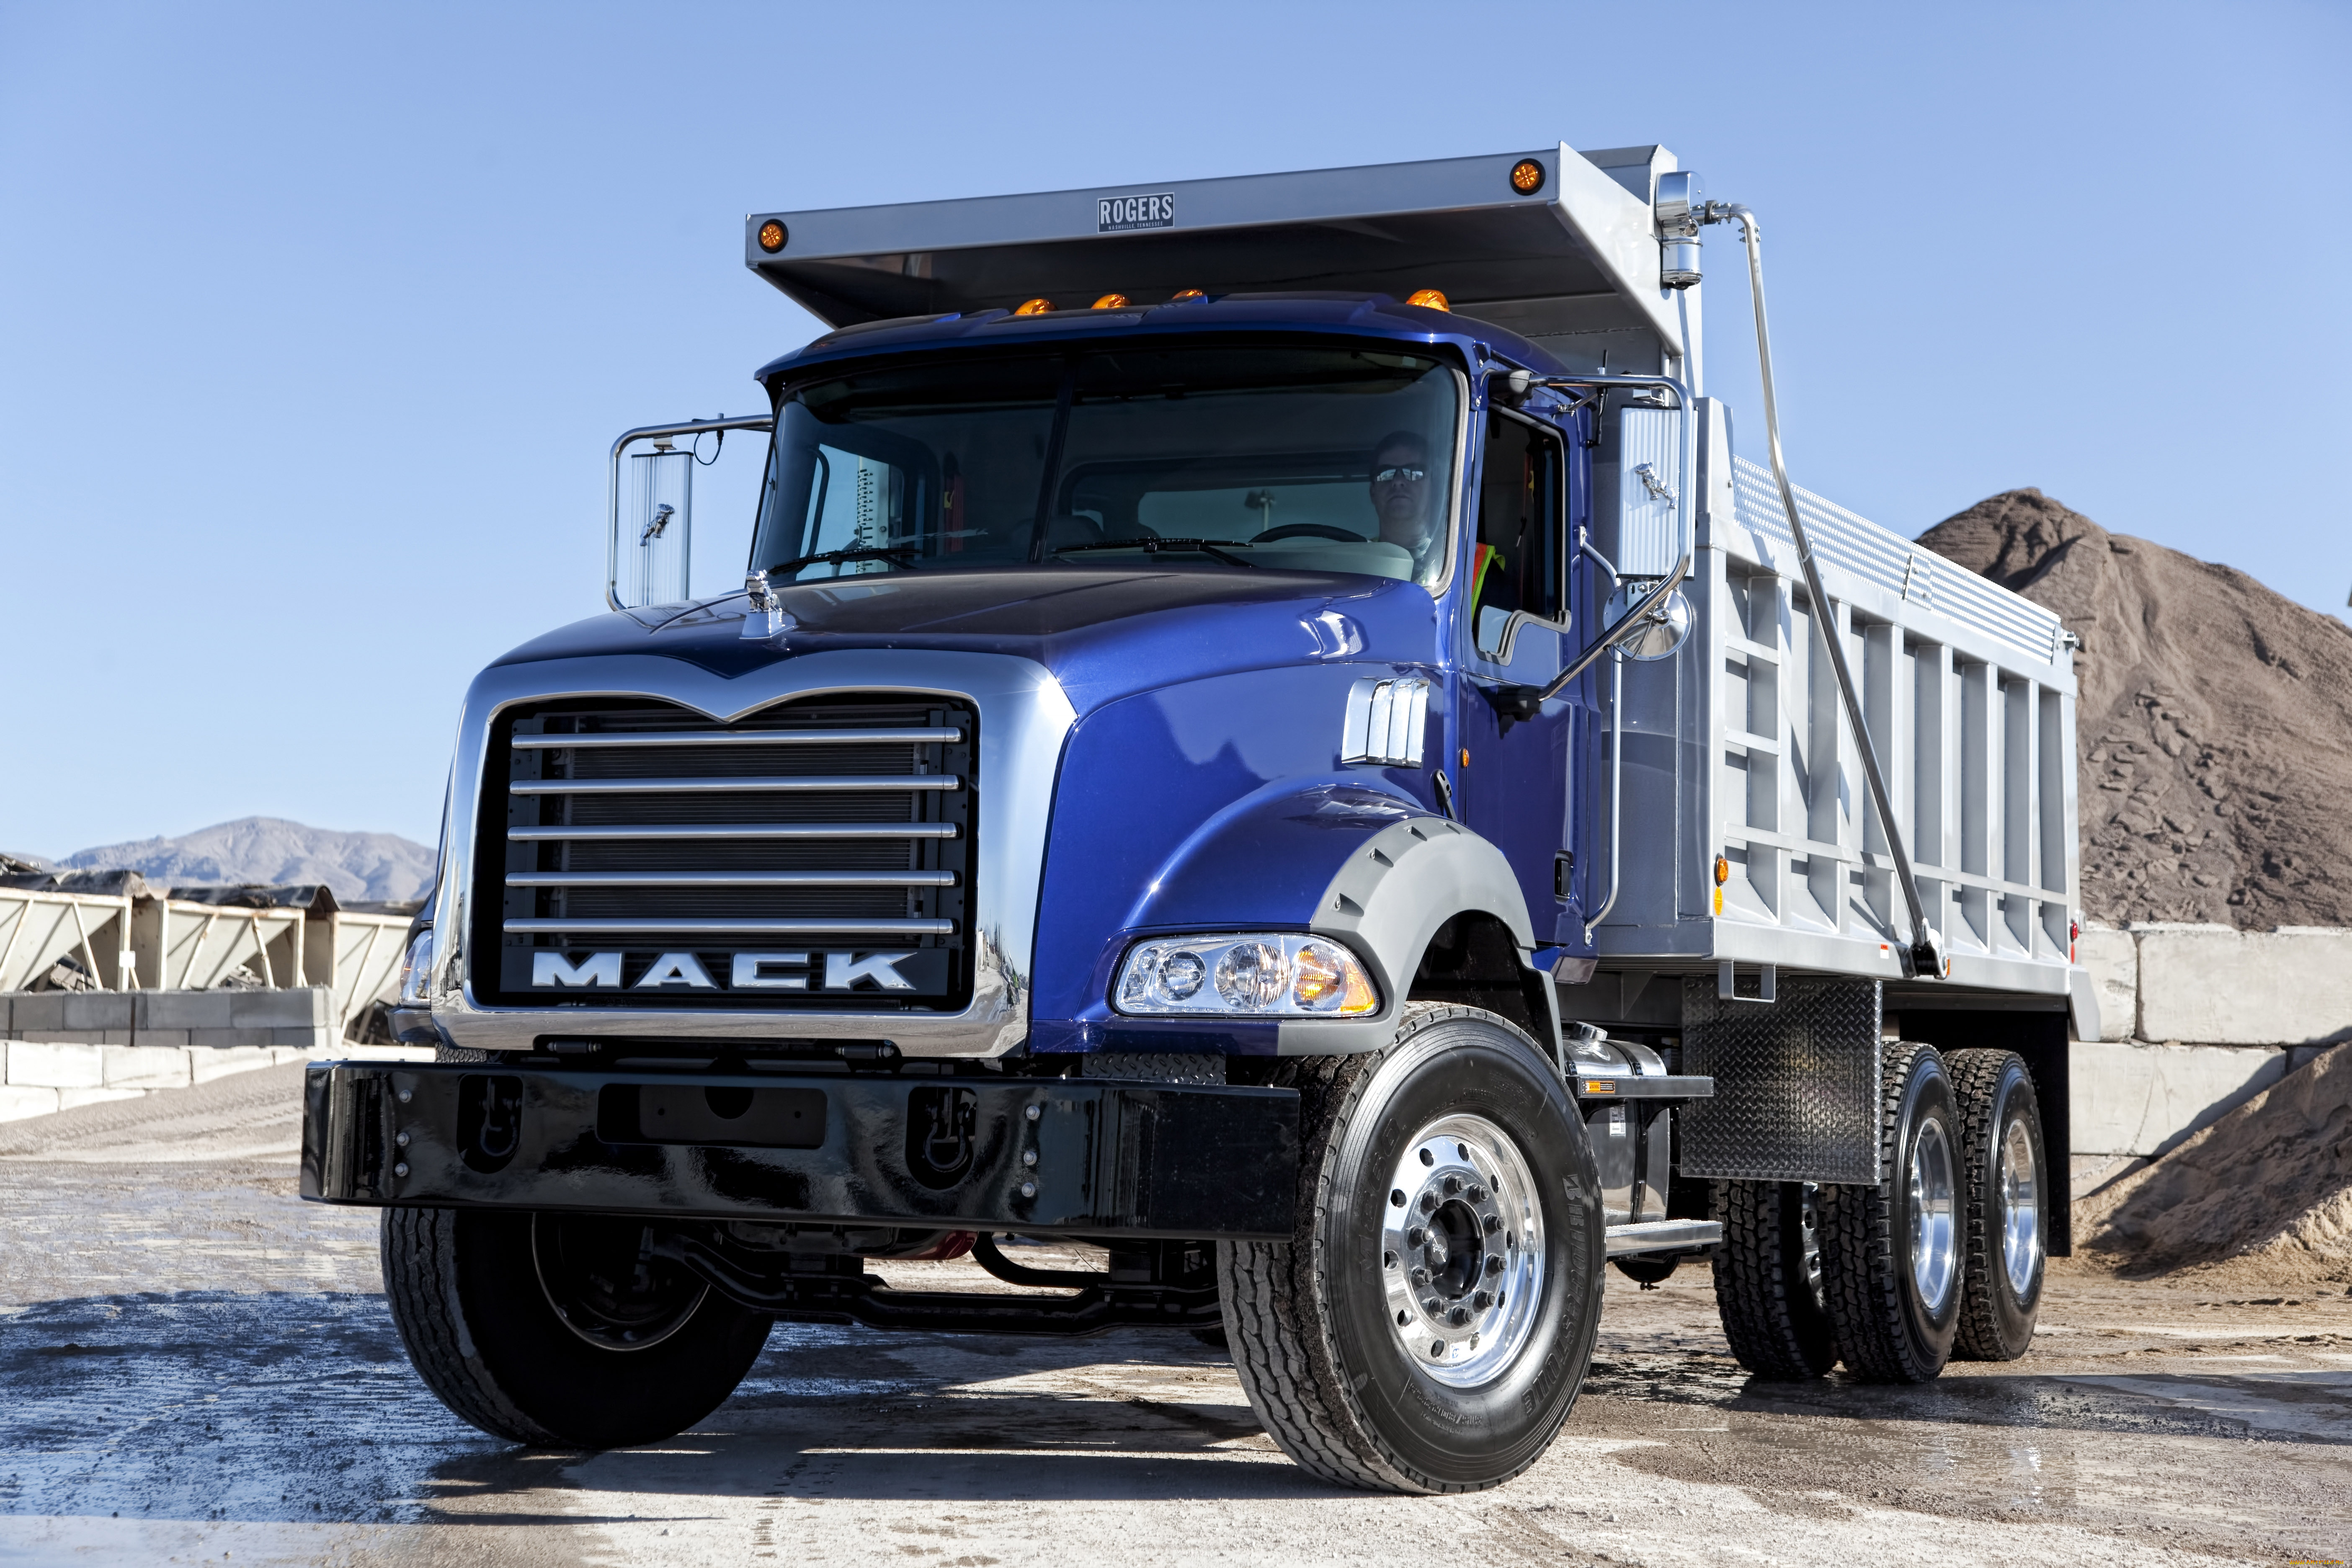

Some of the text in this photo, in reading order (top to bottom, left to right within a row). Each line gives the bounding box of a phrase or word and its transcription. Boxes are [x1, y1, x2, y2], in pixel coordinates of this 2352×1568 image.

[1100, 196, 1172, 224] ROGERS
[531, 951, 917, 990] MACK
[1522, 1173, 1586, 1418] BRIDGESTONE
